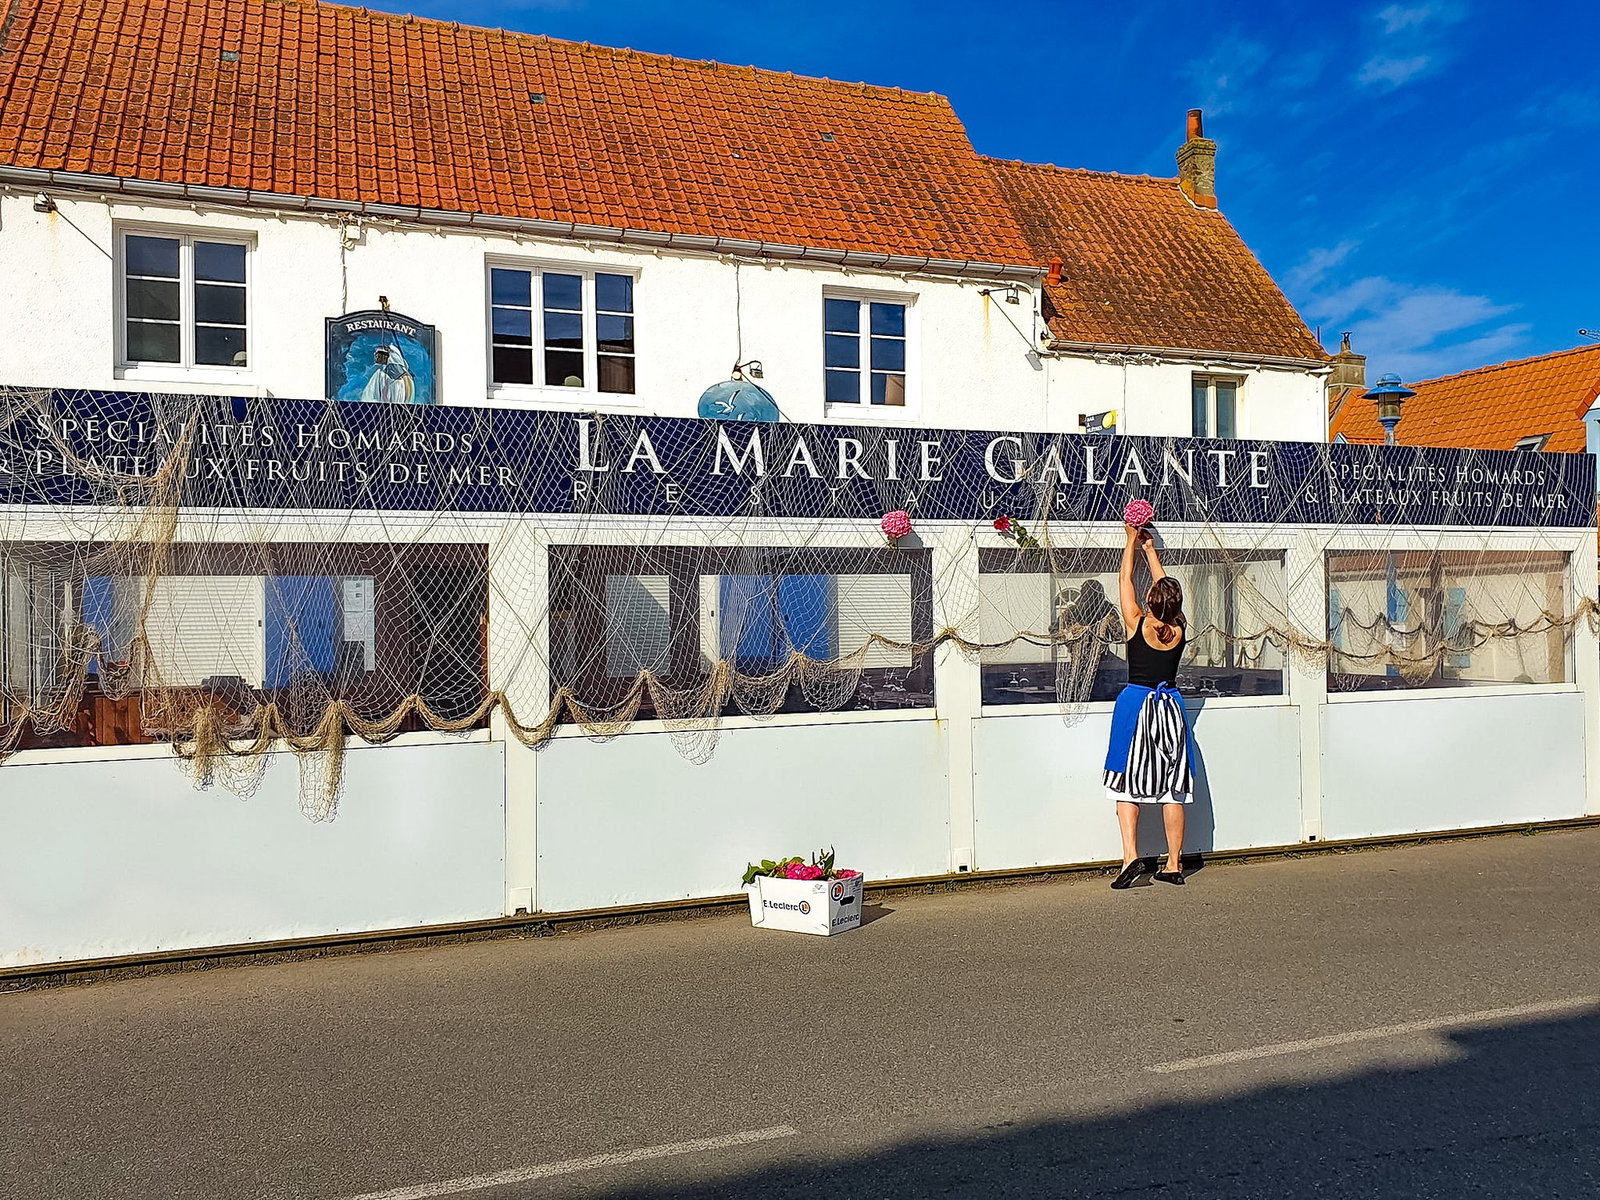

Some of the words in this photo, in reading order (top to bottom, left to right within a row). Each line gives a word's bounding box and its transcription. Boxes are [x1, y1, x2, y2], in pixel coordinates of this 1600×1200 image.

[346, 320, 417, 337] RESTAURANT
[297, 424, 474, 454] HOMARDS
[574, 418, 666, 474] LA
[710, 424, 944, 482] MARIE
[984, 436, 1270, 489] GALANTE
[36, 449, 226, 479] PLATEAUX
[247, 458, 369, 484] FRUITS
[389, 463, 429, 484] DE
[449, 466, 519, 487] MER
[1329, 461, 1446, 483] SPÉCIALITÉS
[1456, 466, 1545, 486] HOMARDS
[573, 480, 1270, 513] RESTAURNT
[1305, 485, 1319, 504] &
[1329, 486, 1422, 506] PLATEAUX
[1431, 490, 1493, 508] FRUITS
[1502, 492, 1523, 508] DE
[1532, 494, 1569, 509] MER
[763, 899, 798, 911] E.Leclerc
